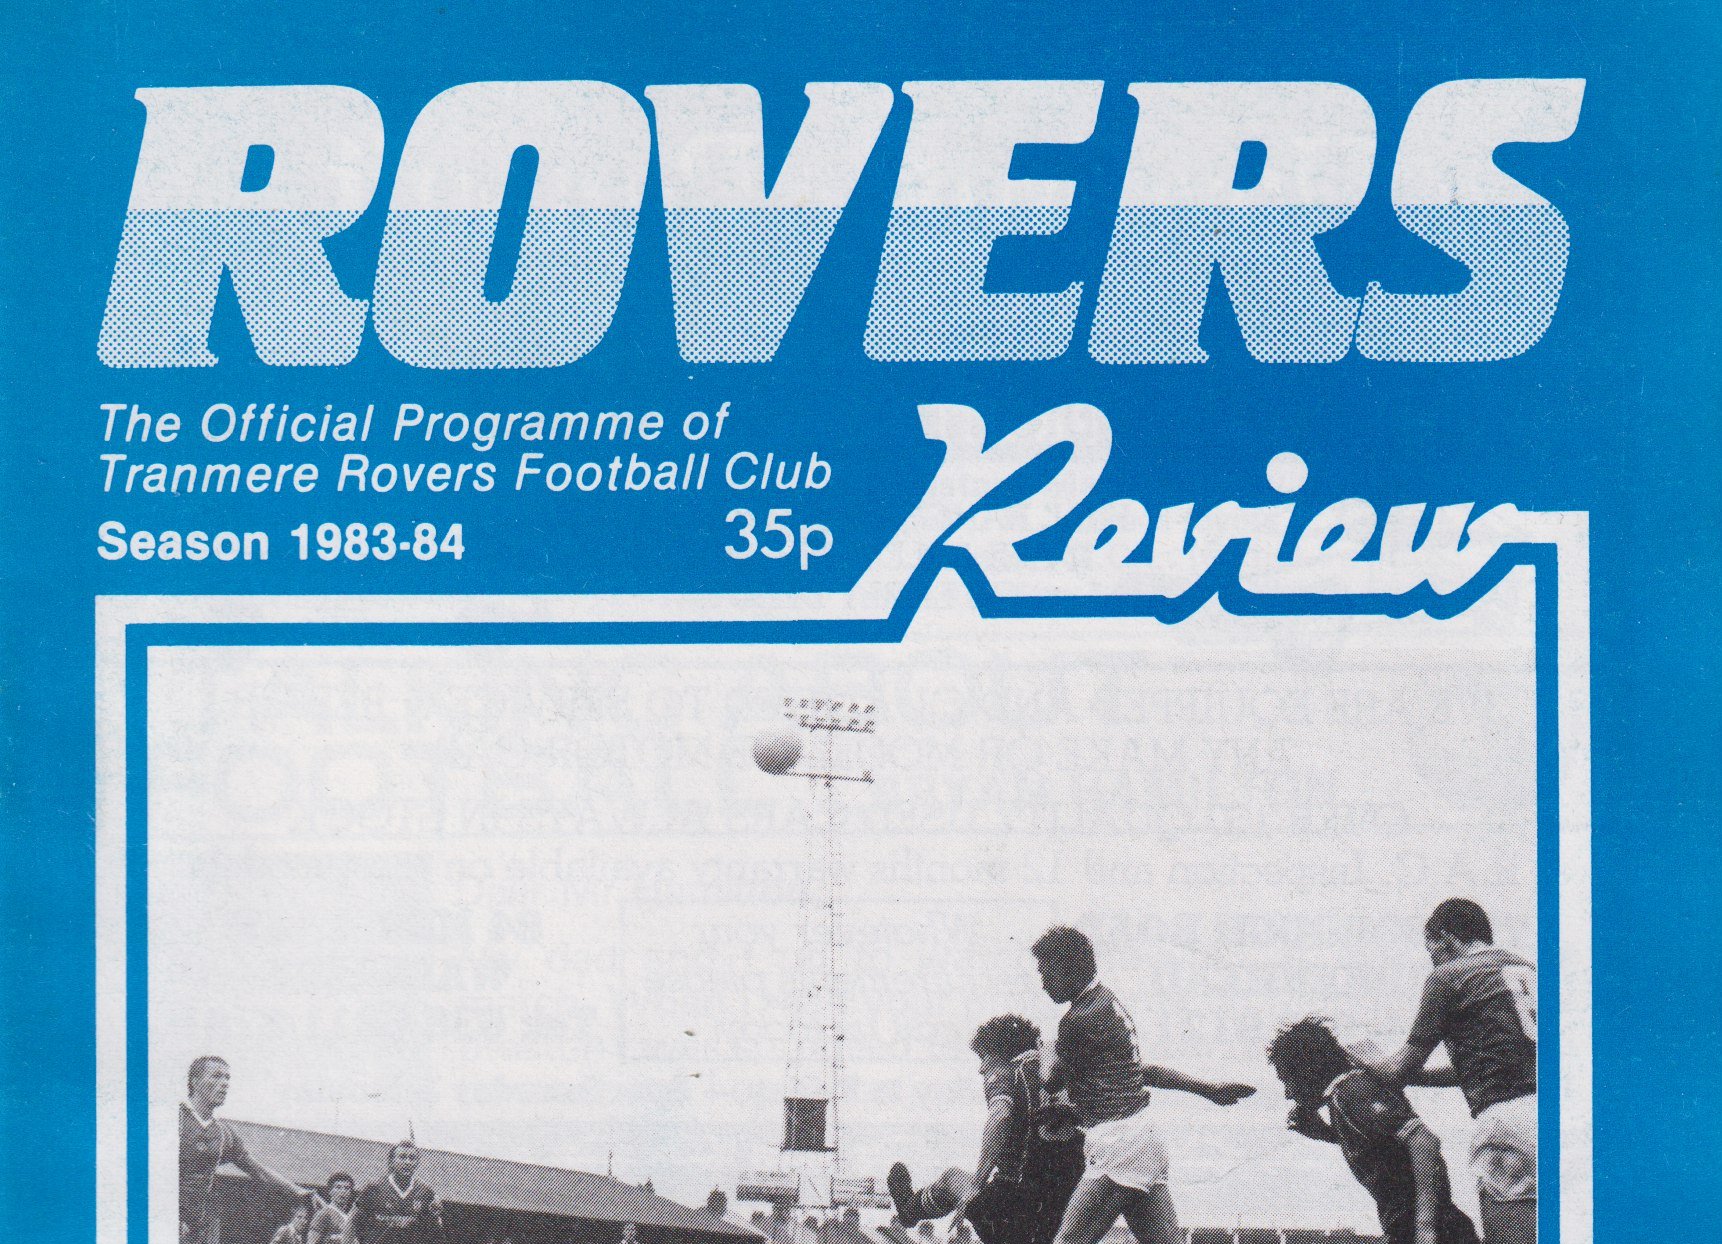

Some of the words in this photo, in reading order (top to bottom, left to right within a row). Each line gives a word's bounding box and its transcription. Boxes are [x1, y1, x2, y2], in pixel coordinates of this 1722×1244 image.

[96, 77, 1587, 370] ROVERS
[100, 403, 181, 443] The
[201, 403, 374, 442] Official
[394, 403, 664, 452] Programme
[683, 402, 730, 440] of
[100, 453, 319, 493] Tranmere
[337, 453, 496, 493] Rovers
[515, 453, 709, 492] Football
[725, 451, 832, 490] Club
[855, 402, 1520, 598] Review
[97, 521, 269, 561] Season
[291, 522, 465, 561] 1983-84
[725, 508, 834, 570] 35p
